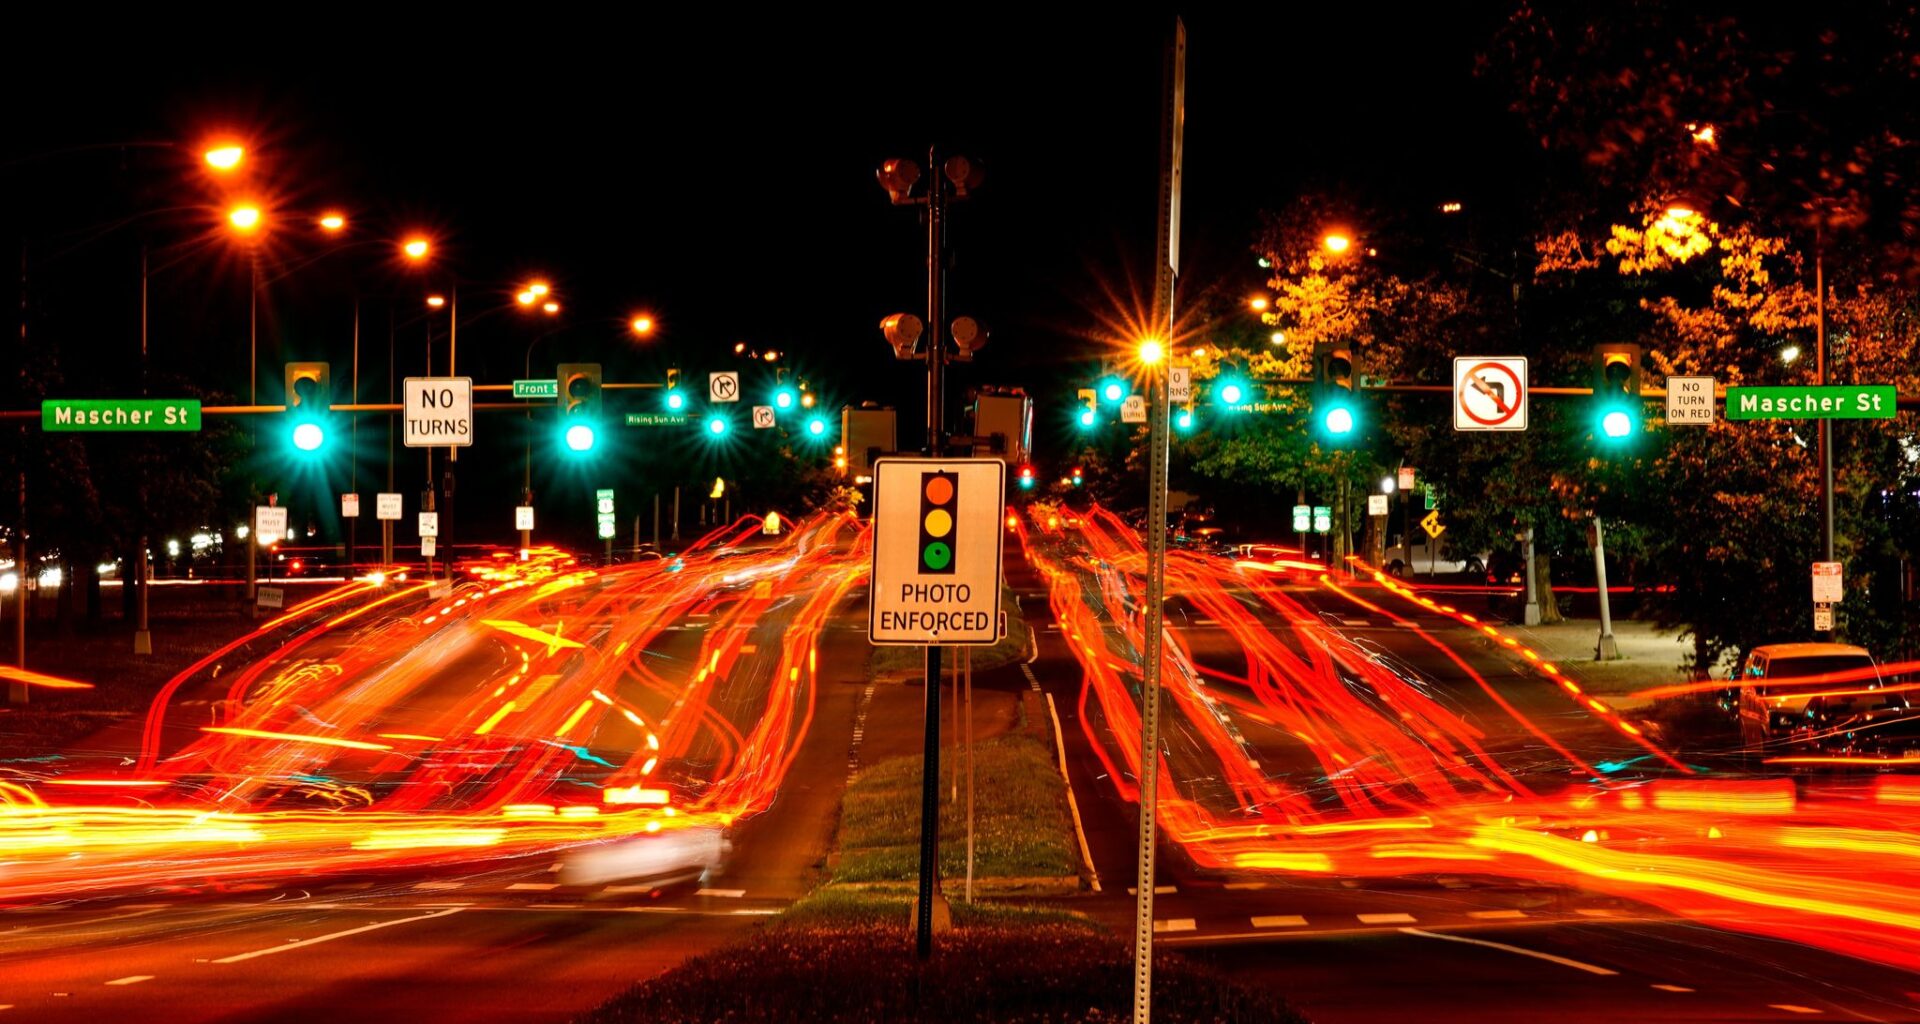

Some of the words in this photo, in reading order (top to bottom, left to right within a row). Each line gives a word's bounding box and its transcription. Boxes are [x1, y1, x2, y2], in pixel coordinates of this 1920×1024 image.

[519, 384, 548, 394] Front
[552, 384, 558, 394] S
[1169, 387, 1188, 397] RNS
[1682, 383, 1700, 392] NO
[422, 389, 454, 409] NO
[1677, 396, 1705, 405] TURN
[1740, 394, 1845, 412] Mascher
[1856, 393, 1881, 412] St
[55, 406, 153, 425] Mascher
[164, 406, 188, 425] St
[628, 415, 653, 425] Rising
[654, 415, 669, 424] Sun
[670, 415, 685, 424] Ave
[1671, 409, 1685, 418] ON
[1690, 409, 1711, 418] RED
[408, 419, 468, 436] TURNS
[901, 583, 971, 603] PHOTO
[880, 611, 989, 631] ENFORCED
